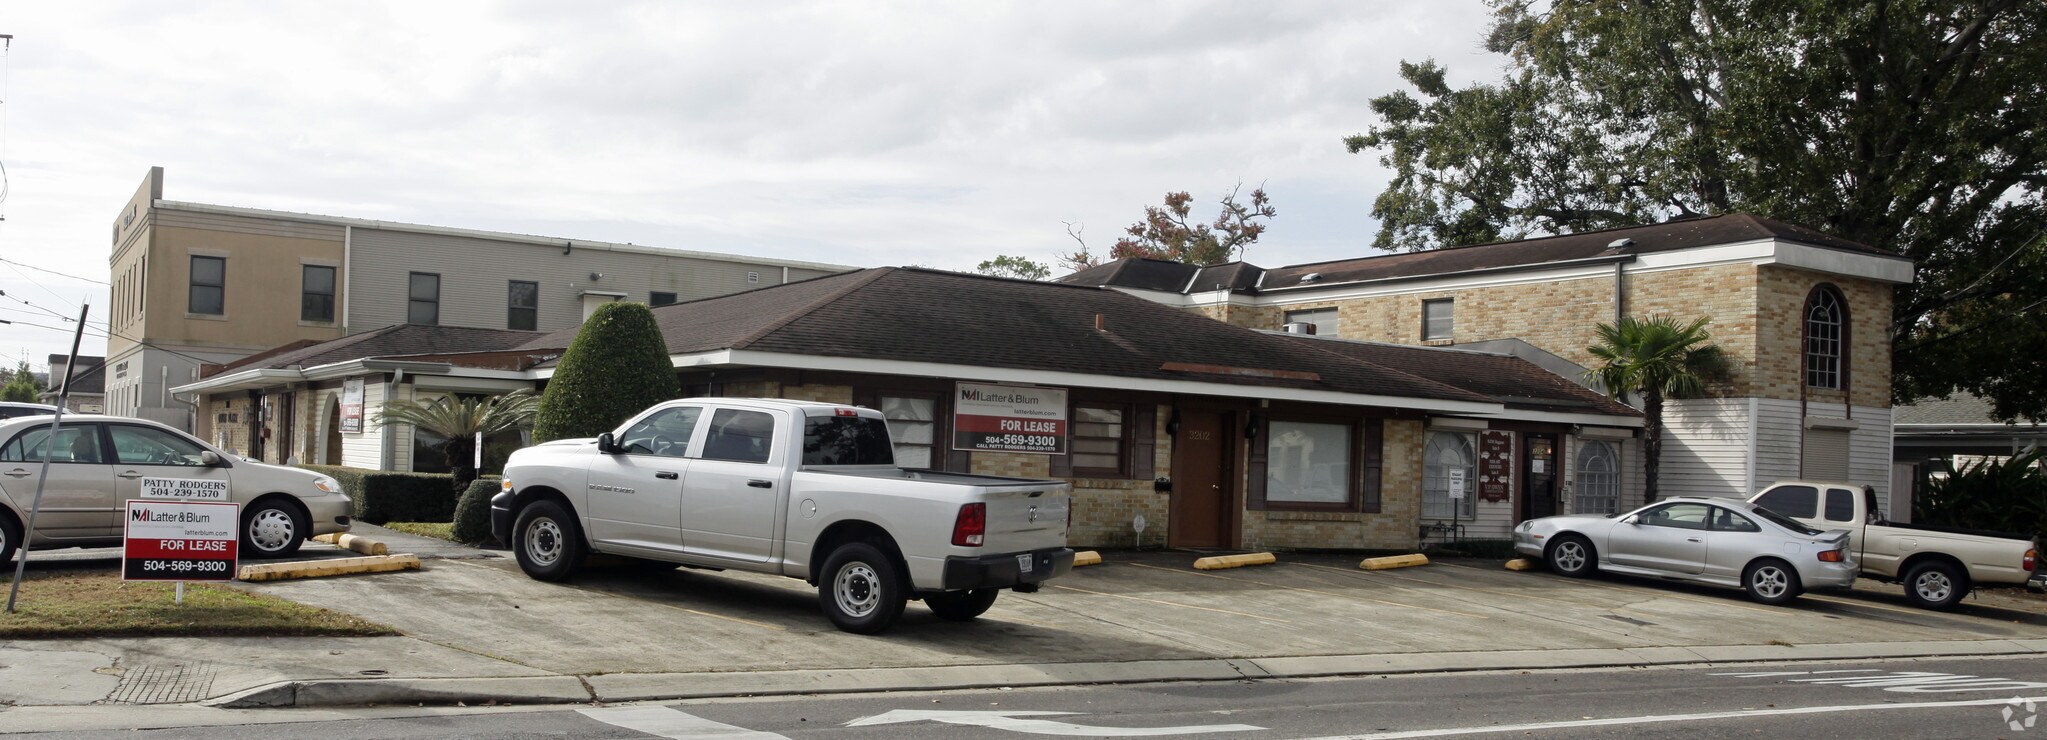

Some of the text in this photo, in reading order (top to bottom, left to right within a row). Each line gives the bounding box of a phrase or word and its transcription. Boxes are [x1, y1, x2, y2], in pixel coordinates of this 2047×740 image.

[962, 389, 980, 401] NAI
[980, 392, 1006, 403] Latter
[1007, 394, 1015, 404] &
[1015, 395, 1039, 405] Blum
[1000, 420, 1056, 433] FOR LEASE
[985, 434, 1056, 446] 504-569-9300
[1189, 430, 1210, 440] 3202
[144, 479, 226, 490] PATTY RODGERS
[589, 483, 612, 491] RAM
[150, 488, 219, 498] 504-239-1570
[132, 508, 210, 523] NAI Latter & Blum
[184, 529, 228, 537] latterblum.com
[160, 540, 227, 551] FOR LEASE
[143, 560, 226, 571] 504-569-9300
